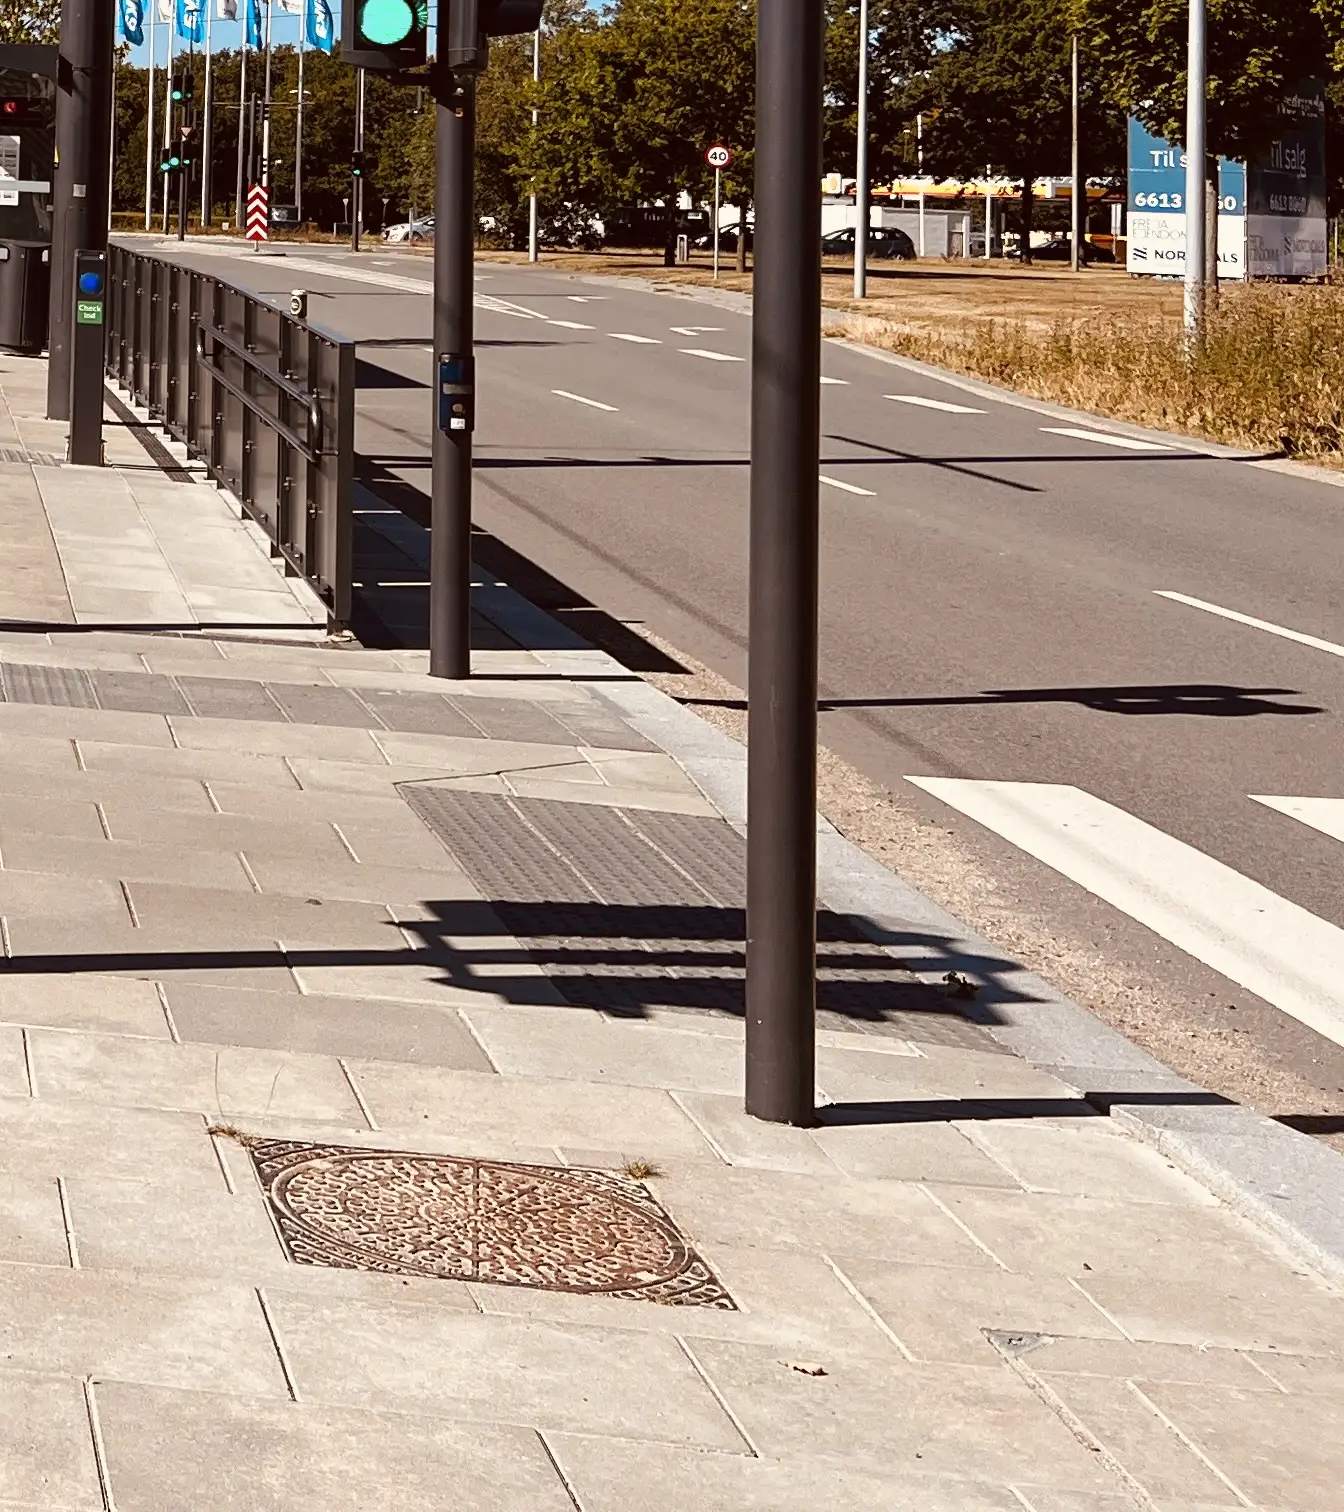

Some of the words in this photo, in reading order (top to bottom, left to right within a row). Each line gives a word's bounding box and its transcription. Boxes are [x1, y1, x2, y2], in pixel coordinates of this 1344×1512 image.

[709, 151, 728, 161] 40
[1150, 150, 1176, 168] Til
[1284, 142, 1307, 179] salg
[1134, 192, 1182, 209] 6613
[78, 304, 101, 313] Check
